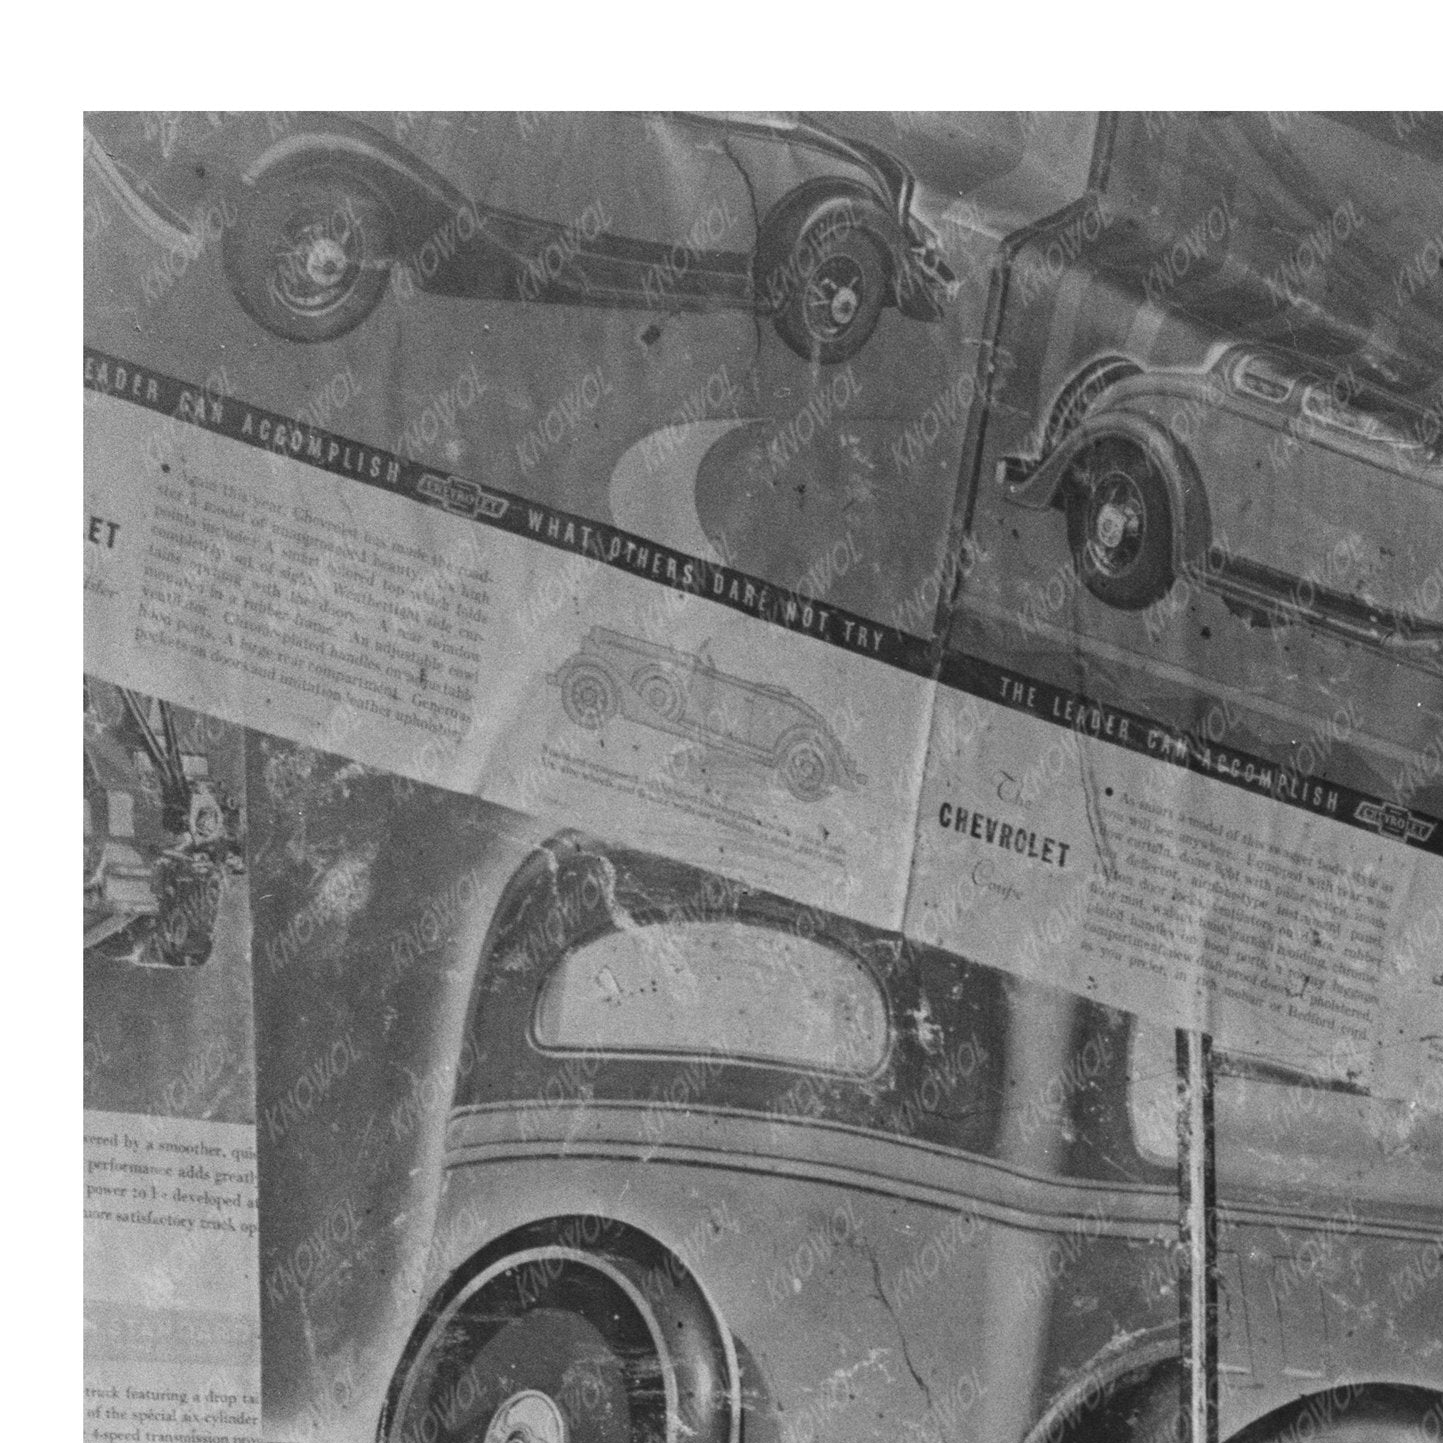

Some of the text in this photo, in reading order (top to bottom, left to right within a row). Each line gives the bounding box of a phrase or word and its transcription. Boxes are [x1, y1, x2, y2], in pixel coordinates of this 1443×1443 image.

[179, 391, 224, 424] CAN
[242, 412, 399, 484] ACCOMPLISH
[528, 509, 884, 652] WHAT OTHERS DARE NOT TRY
[1000, 676, 1338, 813] THE LEADER CAN ACCOMPLISH
[939, 802, 1070, 868] CHEVROLET
